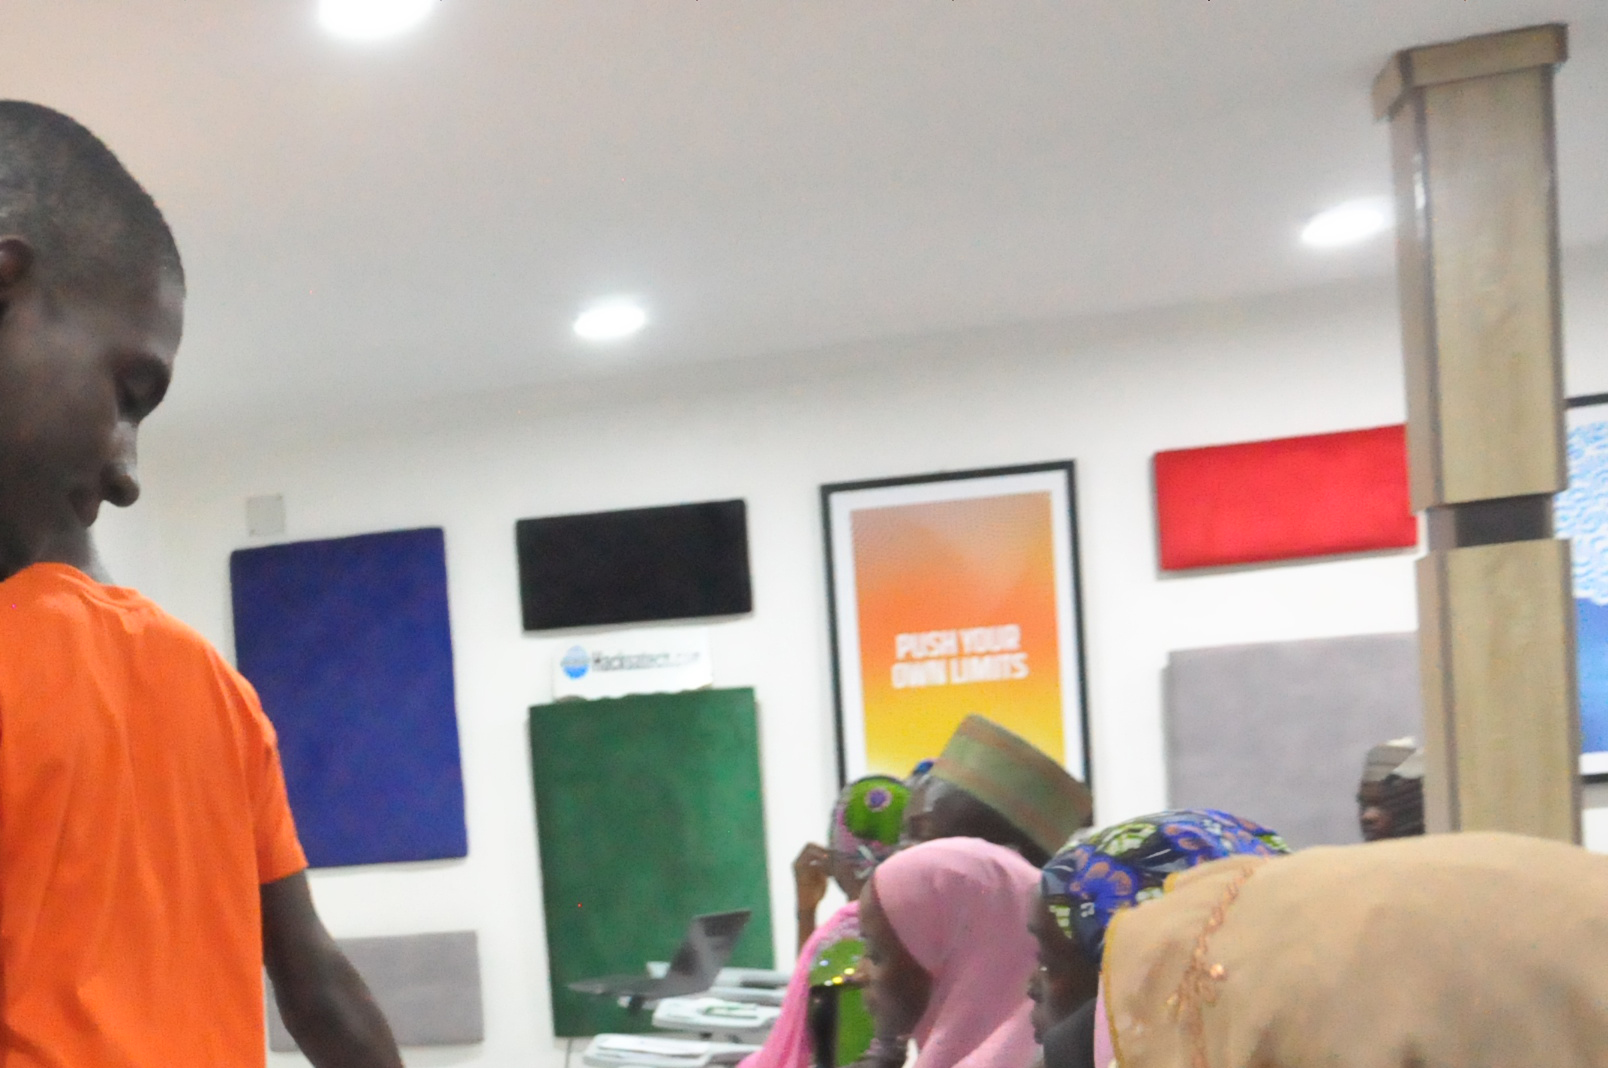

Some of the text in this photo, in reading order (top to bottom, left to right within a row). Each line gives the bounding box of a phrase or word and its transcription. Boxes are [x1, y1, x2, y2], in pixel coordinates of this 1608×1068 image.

[895, 623, 1022, 660] PUSH YOUR
[891, 651, 1030, 689] OWN LIMITS
